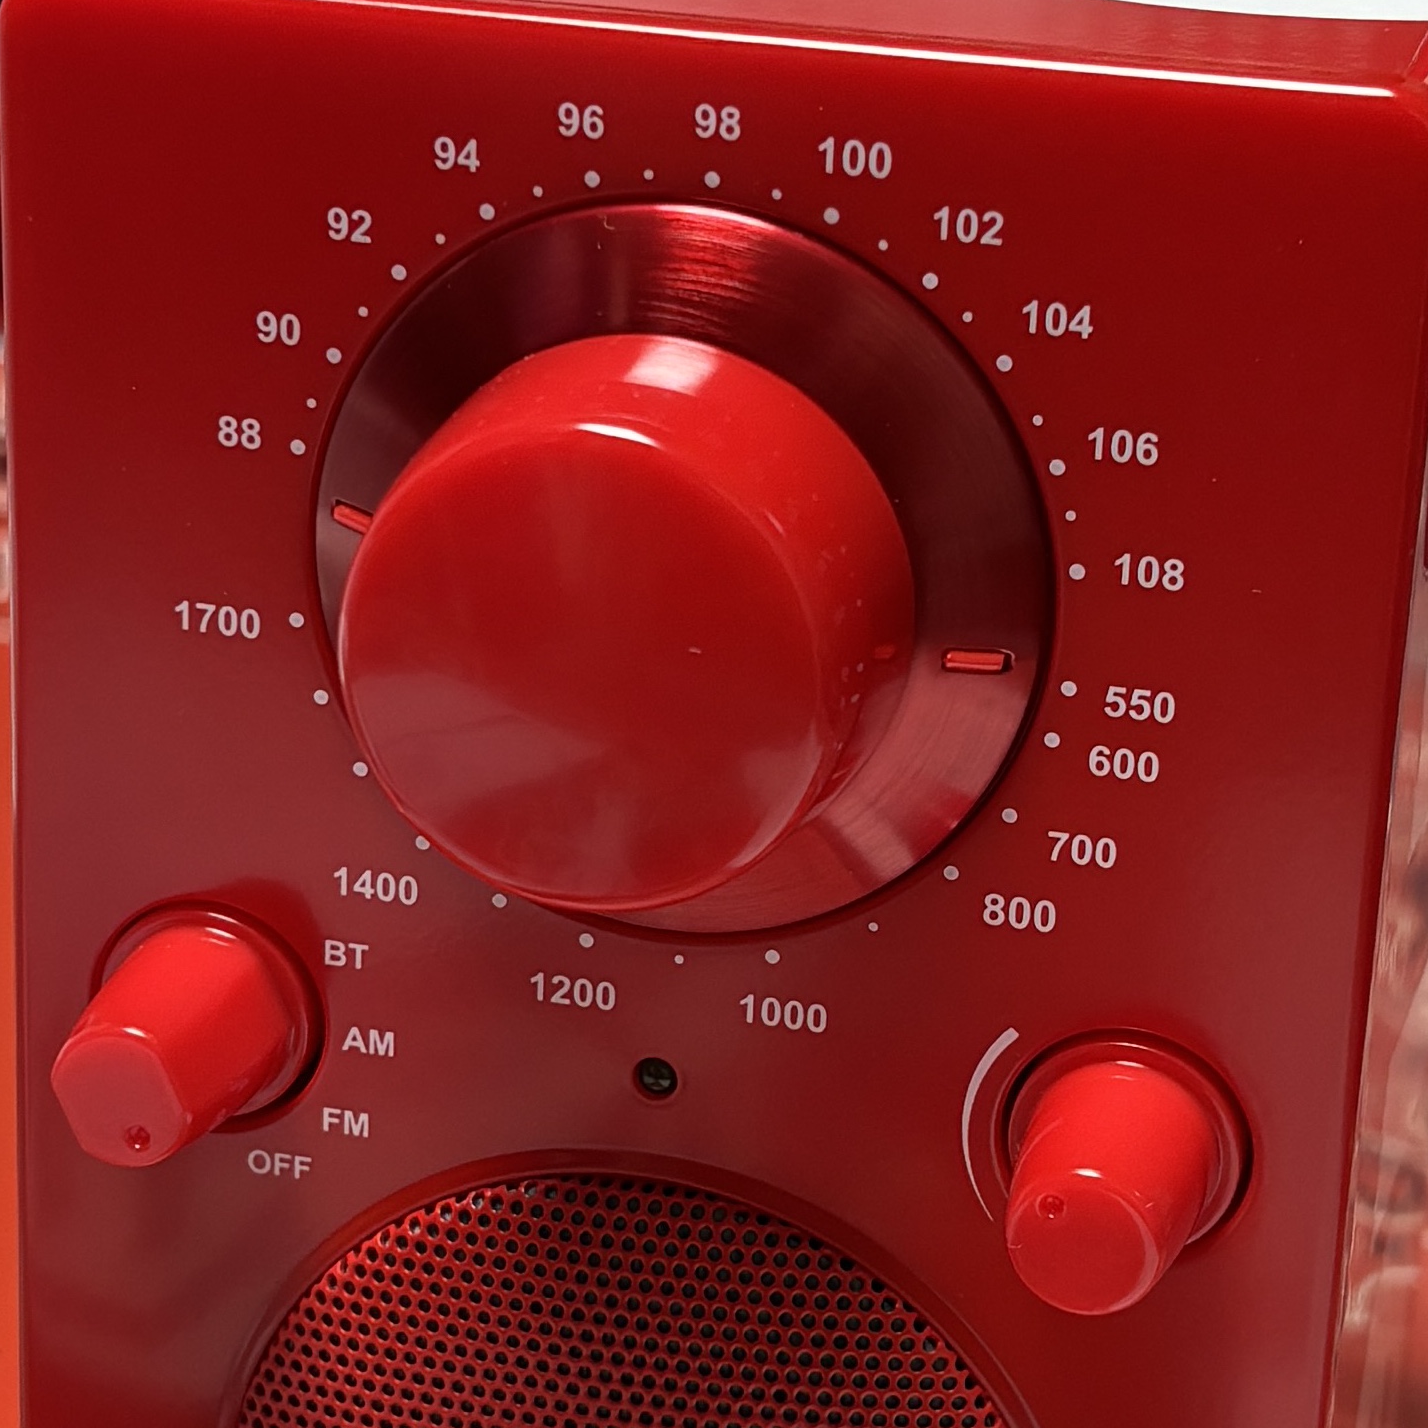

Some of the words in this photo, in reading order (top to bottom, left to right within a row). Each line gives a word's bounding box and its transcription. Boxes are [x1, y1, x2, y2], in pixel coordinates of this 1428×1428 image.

[558, 102, 604, 139] 96
[694, 103, 741, 141] 98
[434, 136, 481, 173] 94
[818, 136, 892, 179] 100
[327, 207, 372, 244] 92
[933, 206, 1004, 246] 102
[256, 310, 301, 346] 90
[1022, 300, 1094, 340] 104
[217, 415, 261, 450] 88
[1088, 427, 1159, 466] 106
[1114, 553, 1185, 592] 108
[174, 600, 261, 639] 1700
[1104, 685, 1176, 724] 550
[1088, 745, 1159, 783] 600
[1047, 830, 1117, 869] 700
[333, 866, 418, 906] 1400
[982, 893, 1056, 933] 800
[324, 939, 369, 970] BT
[530, 972, 616, 1011] 1200
[739, 994, 827, 1033] 1000
[342, 1026, 394, 1057] AM
[322, 1107, 369, 1138] FM
[247, 1149, 312, 1179] OFF
